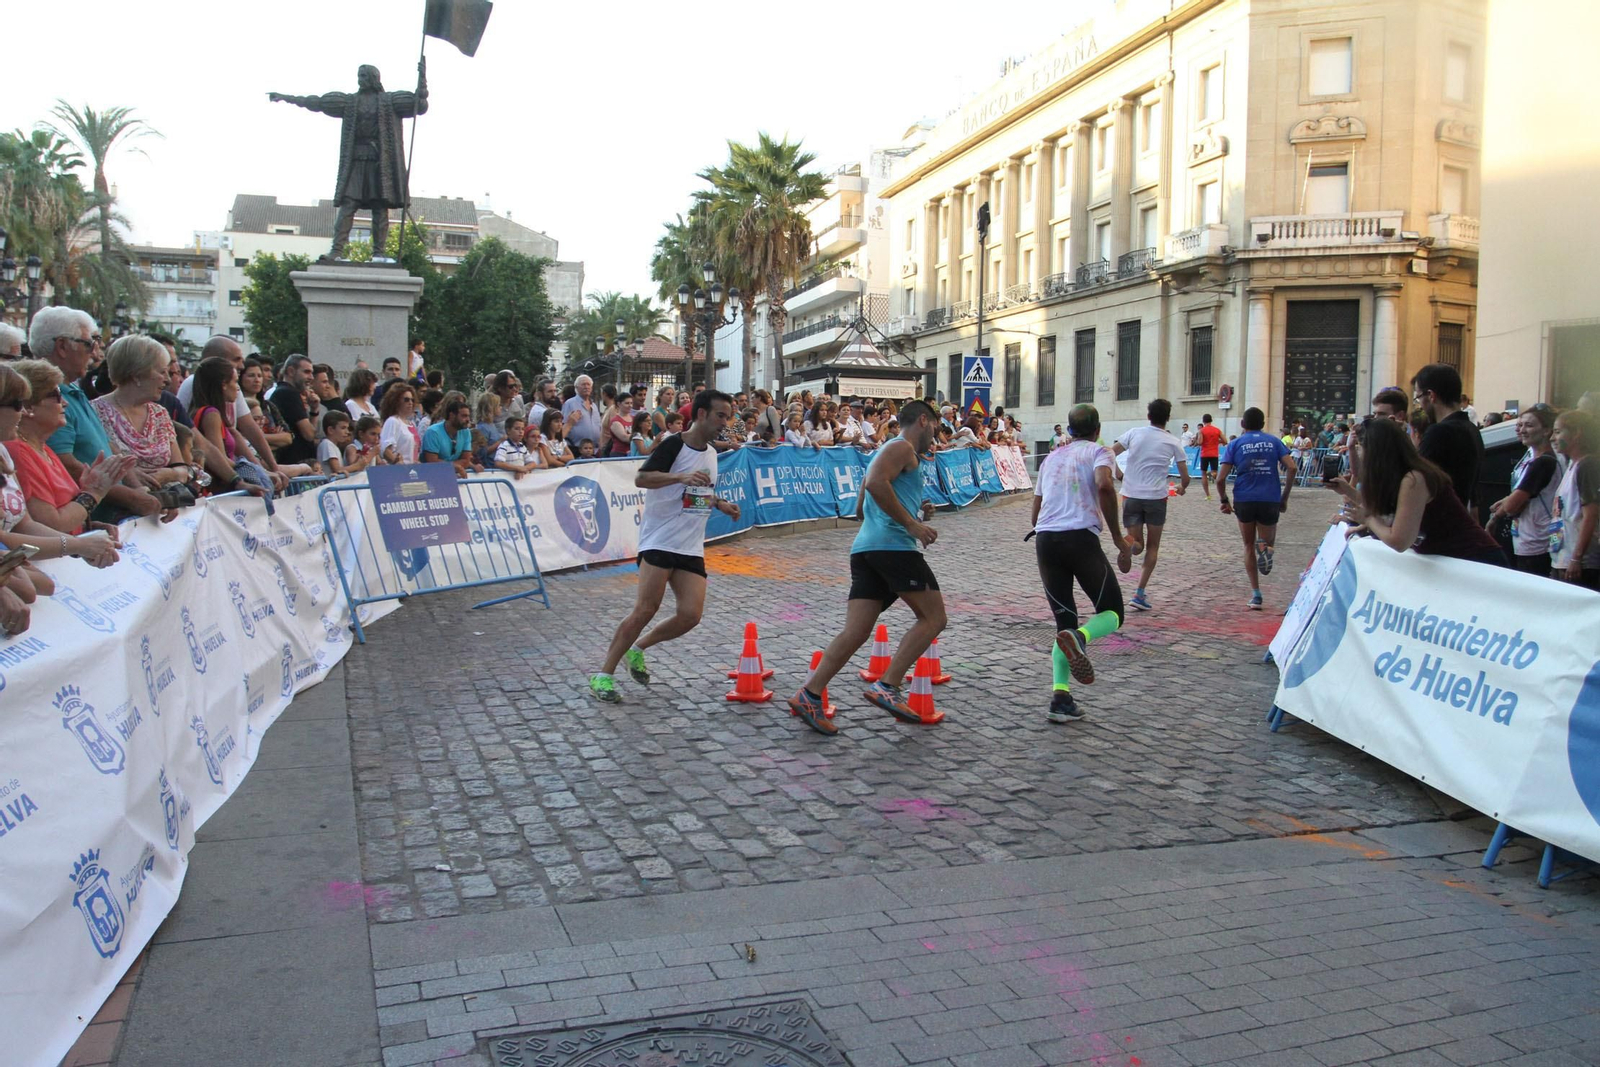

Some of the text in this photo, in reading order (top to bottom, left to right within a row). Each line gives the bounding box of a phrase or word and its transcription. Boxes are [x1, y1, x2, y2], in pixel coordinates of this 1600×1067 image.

[340, 336, 376, 347] HUELVA
[780, 482, 825, 496] DE HUELVA
[380, 497, 459, 515] CAMBIO DE RUEDAS
[695, 497, 705, 506] 35
[399, 514, 450, 530] WHEEL STOP
[97, 590, 141, 615] HUELVA
[1351, 589, 1540, 670] Ayuntamiento
[202, 631, 227, 656] HUELVA
[156, 666, 176, 694] HUELVA
[1373, 644, 1520, 727] de Huelva
[216, 735, 237, 763] HUELVA
[9, 778, 21, 792] de
